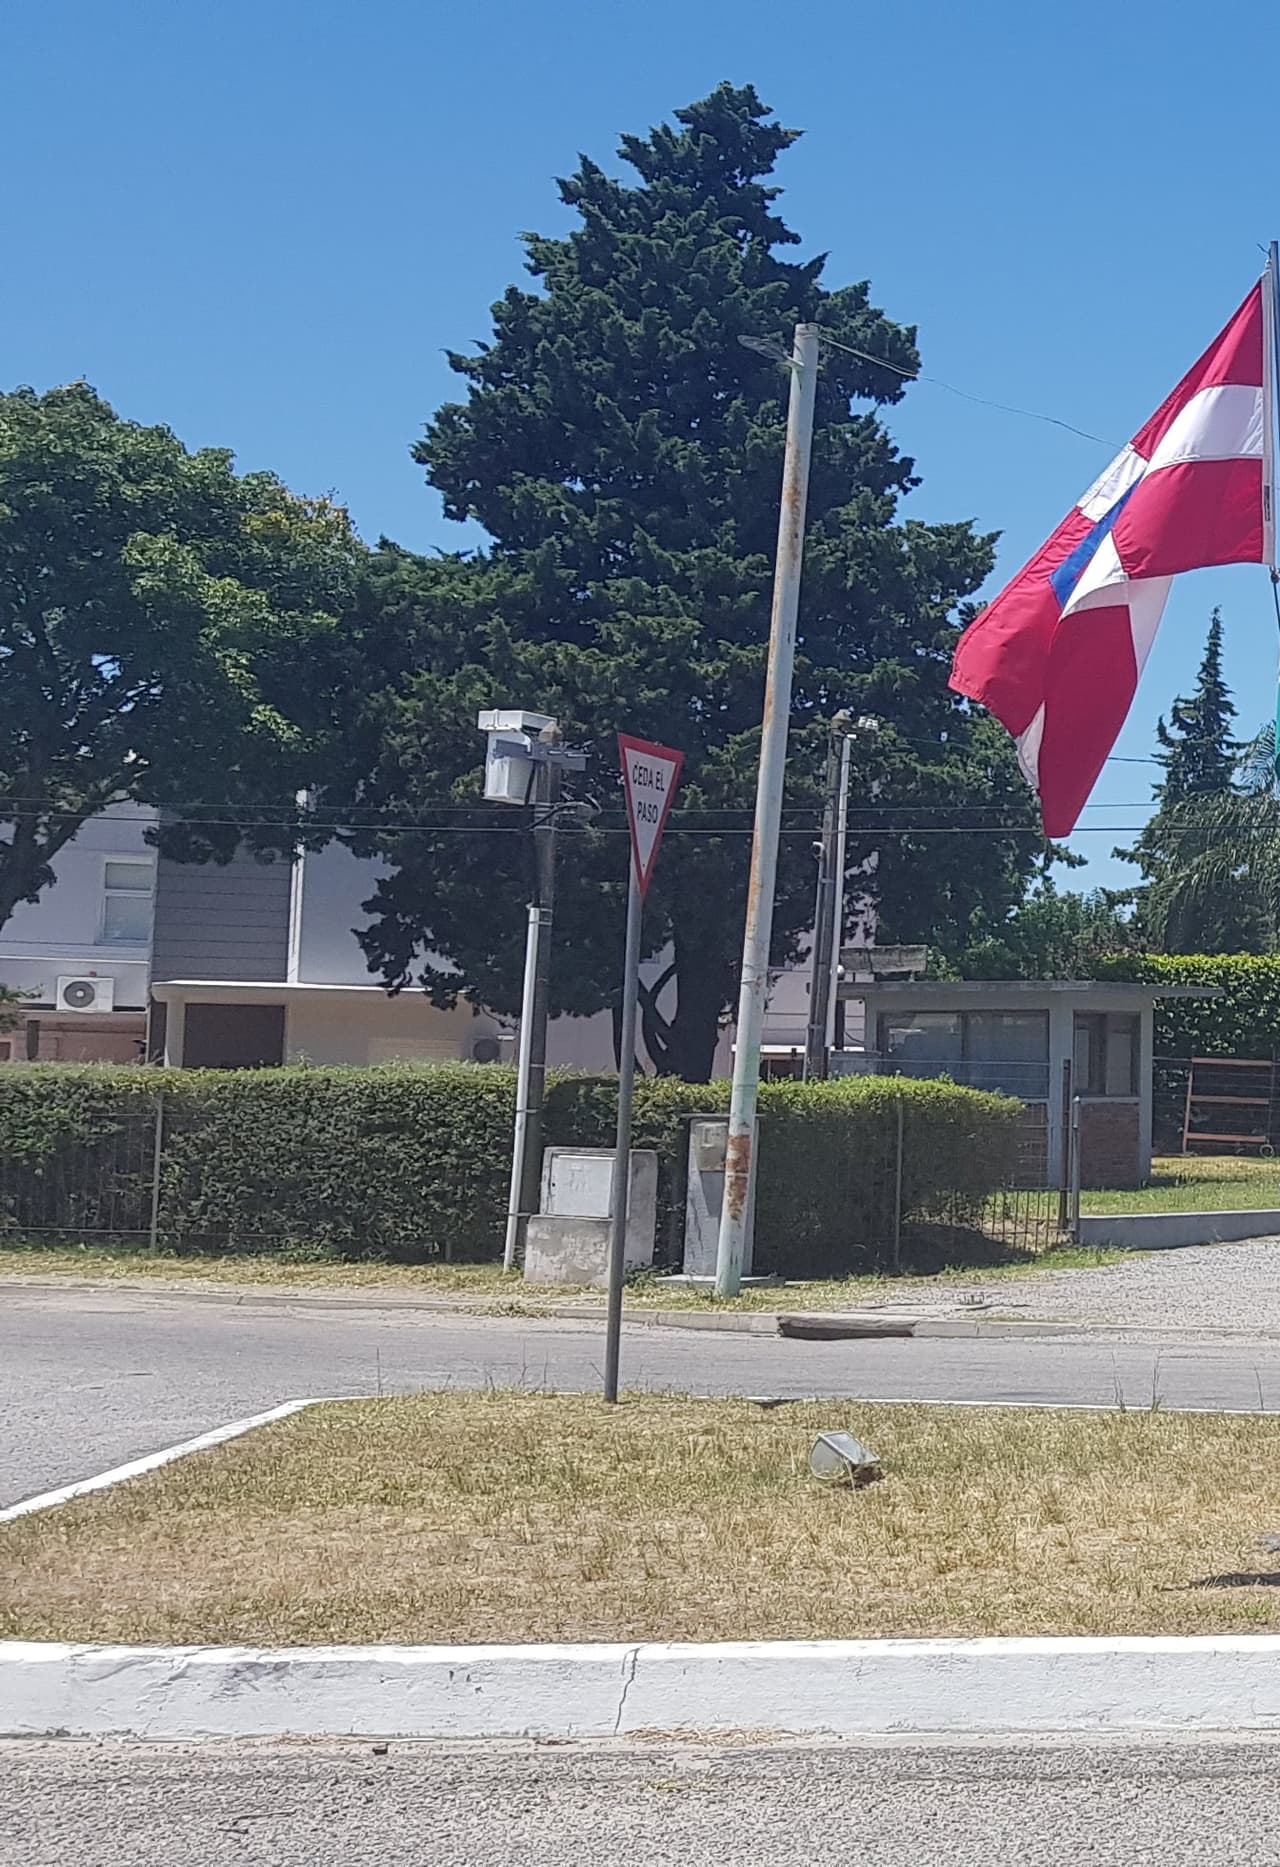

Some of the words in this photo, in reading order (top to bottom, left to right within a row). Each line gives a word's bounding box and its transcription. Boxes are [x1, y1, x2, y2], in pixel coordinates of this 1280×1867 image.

[632, 762, 654, 790] CEDA
[655, 771, 665, 792] EL
[636, 801, 659, 824] PASO
